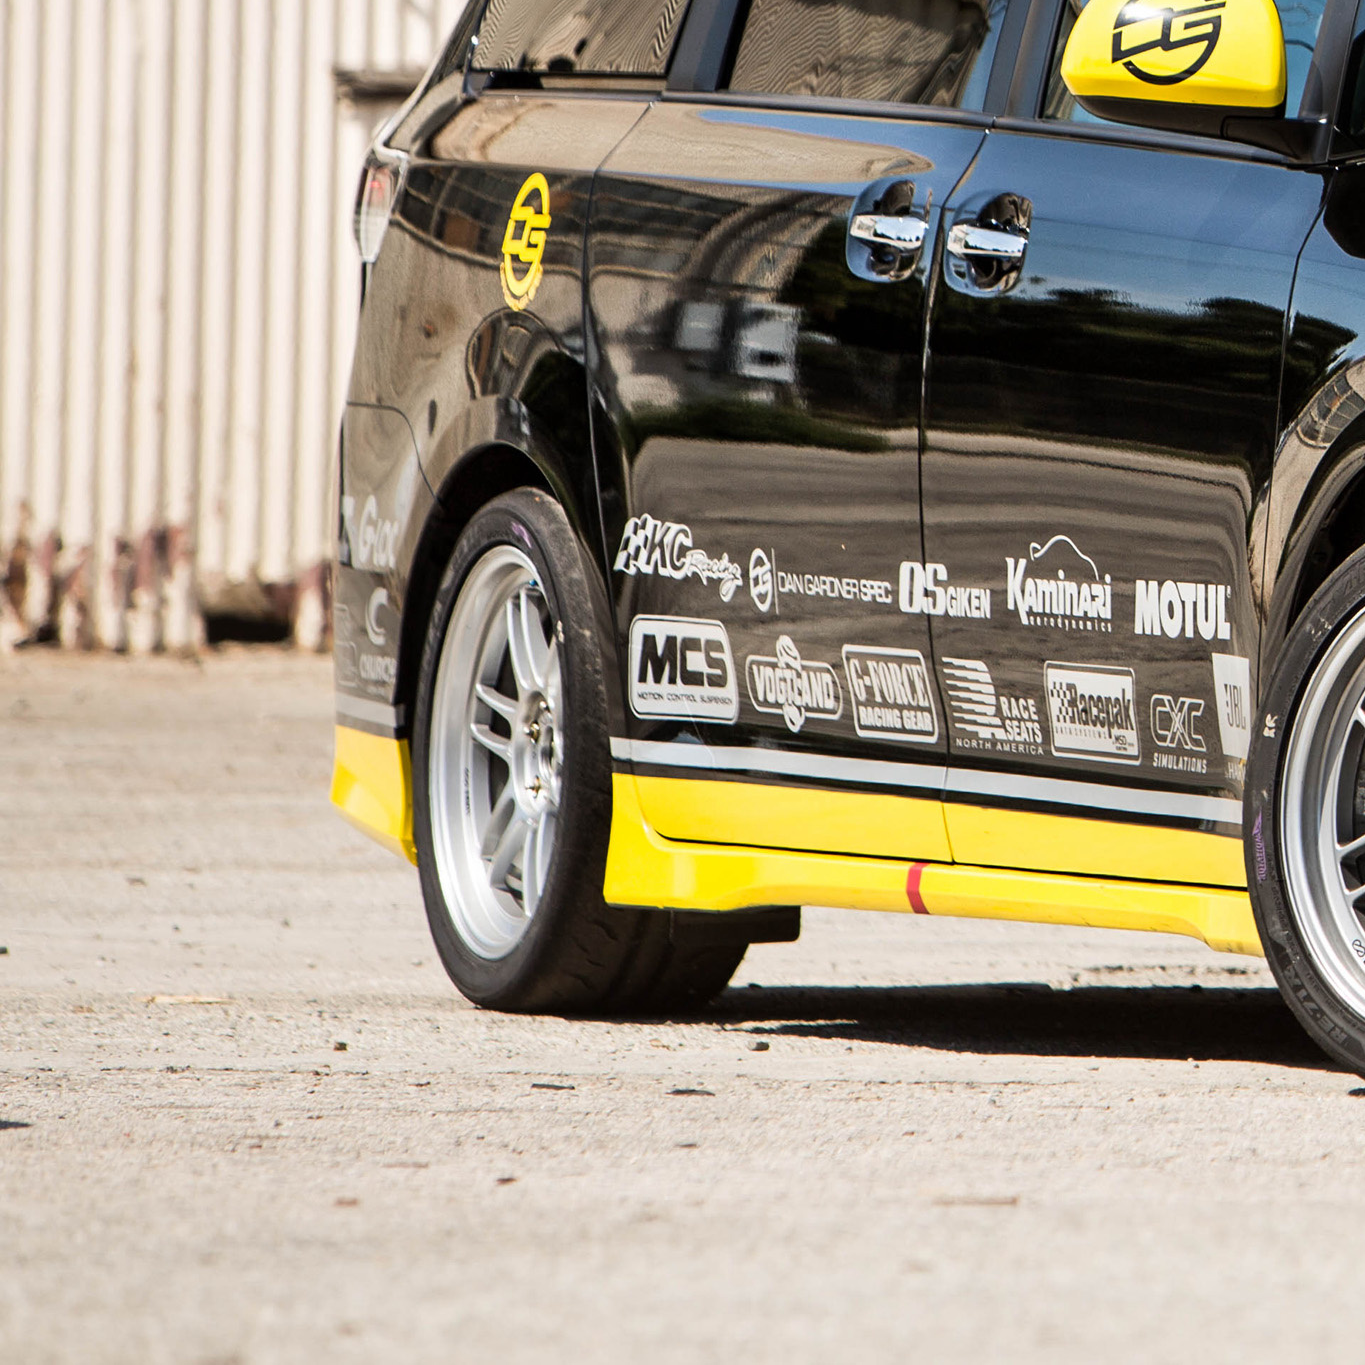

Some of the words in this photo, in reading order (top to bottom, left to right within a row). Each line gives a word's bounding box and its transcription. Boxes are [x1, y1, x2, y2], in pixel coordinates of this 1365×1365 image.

[777, 571, 804, 595] DAN
[804, 574, 860, 600] GARDNER
[860, 579, 892, 604] SPEC
[899, 561, 948, 617] OS
[947, 586, 991, 619] GIKEN
[1134, 579, 1232, 640] MOTUL
[637, 633, 729, 688] MCS
[850, 657, 930, 708] G-FORCE
[752, 664, 835, 709] VOGTLAND
[1000, 696, 1039, 721] RACE
[1226, 683, 1247, 731] JBL
[859, 706, 902, 730] RACING
[902, 709, 934, 732] GEAR
[1005, 720, 1042, 744] SEATS
[1151, 694, 1207, 752] CXC
[956, 738, 992, 750] NORTH
[996, 742, 1044, 756] AMERICA
[1153, 753, 1208, 774] SIMULATIONS
